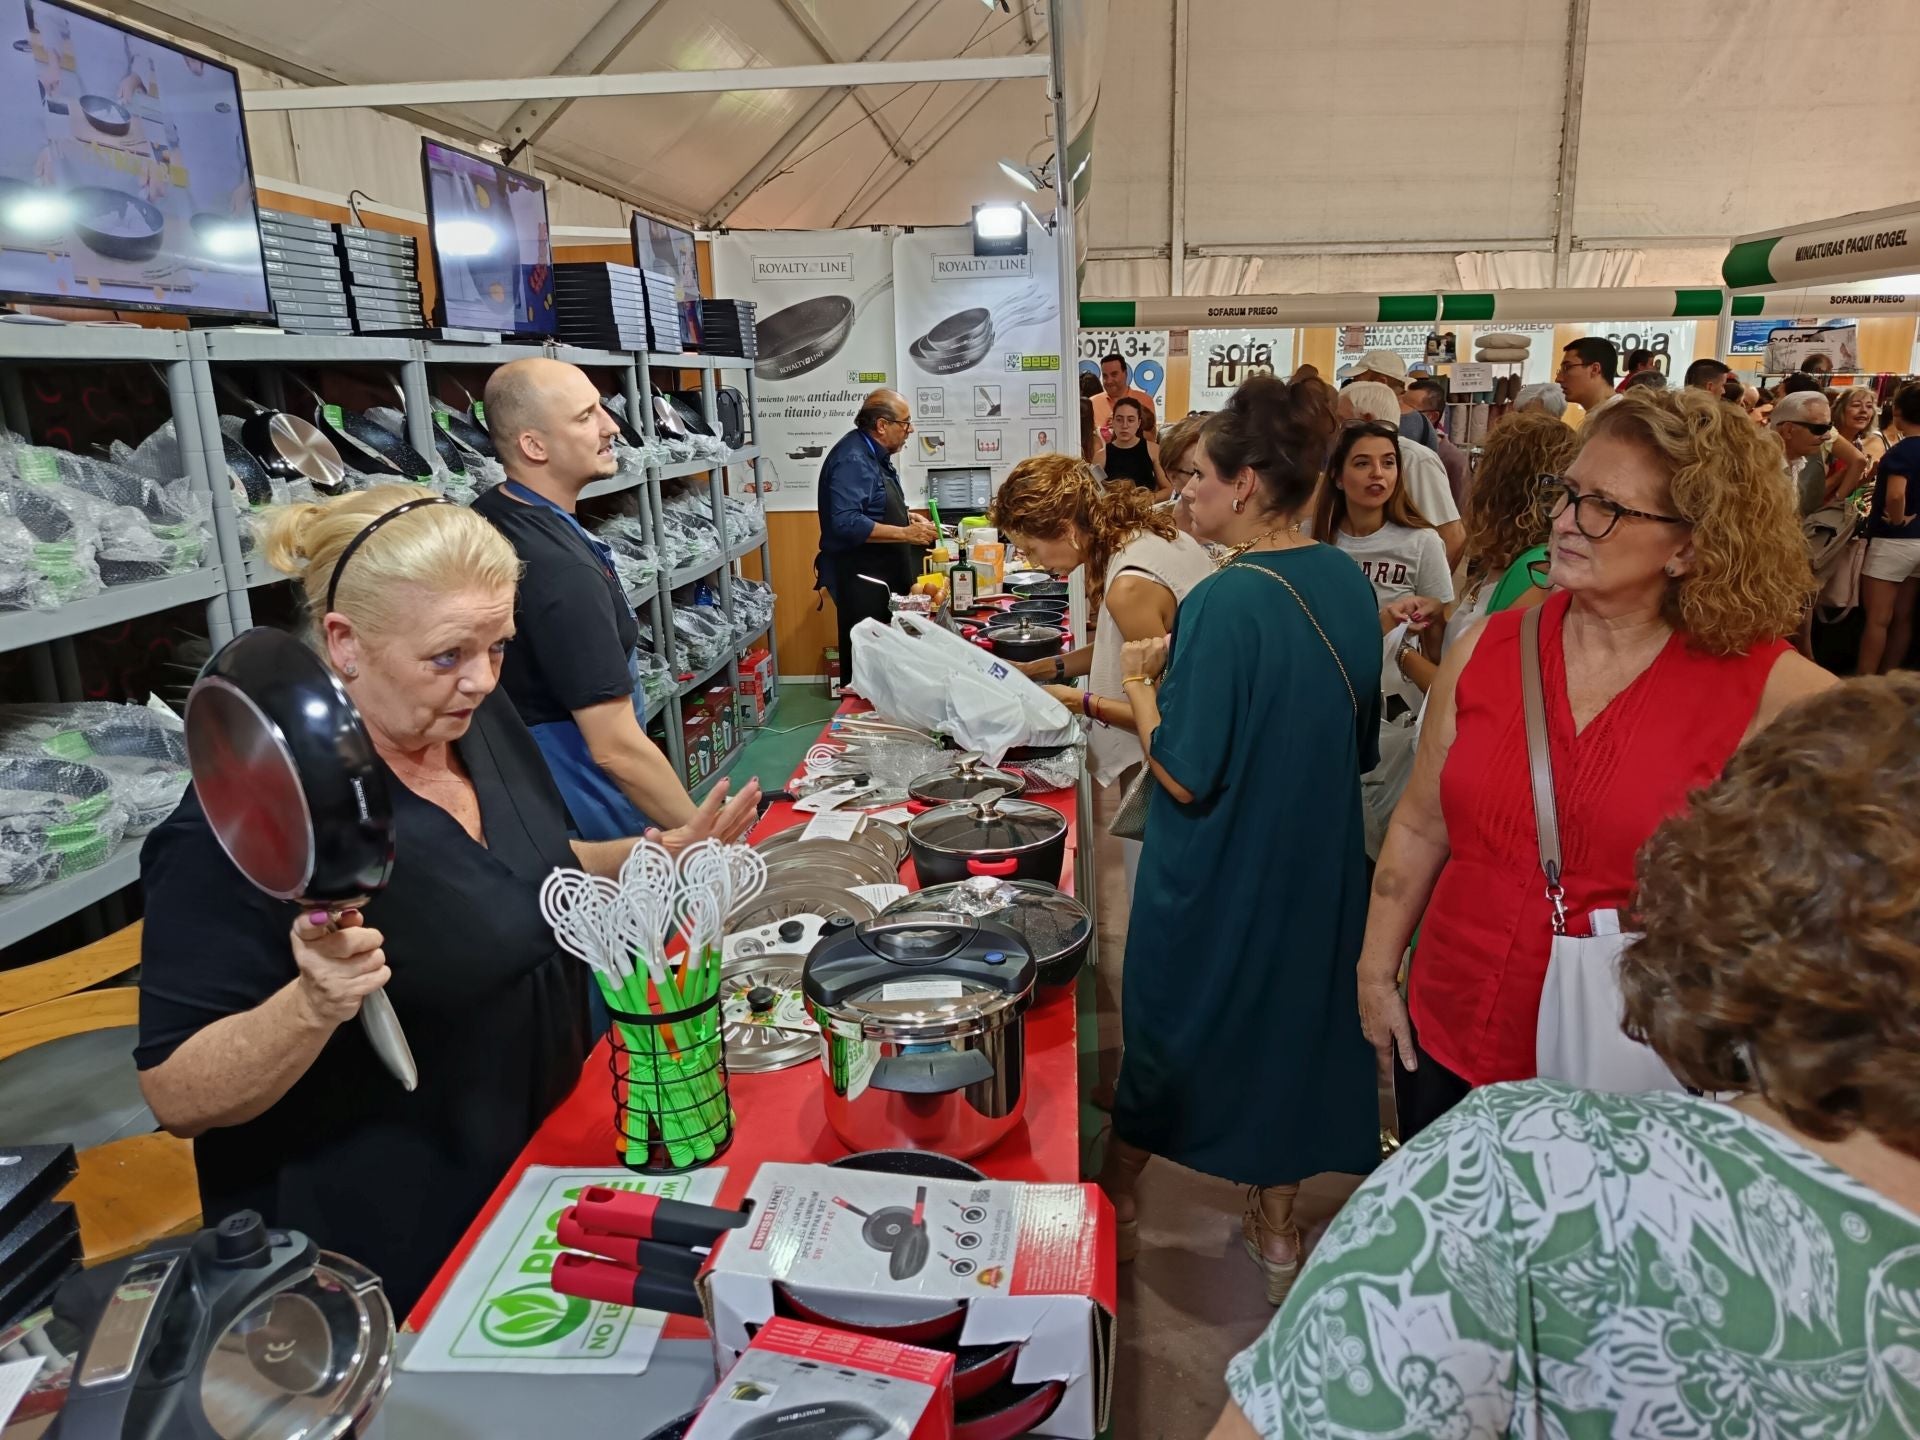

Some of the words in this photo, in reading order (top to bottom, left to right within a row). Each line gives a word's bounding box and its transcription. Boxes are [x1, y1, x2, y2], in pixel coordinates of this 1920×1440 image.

[1795, 240, 1844, 262] MINIATURAS
[1846, 234, 1874, 254] PAQUI
[1875, 229, 1908, 250] ROGEL
[759, 262, 809, 274] ROYALTY
[820, 262, 847, 273] LINE
[938, 260, 988, 273] ROYALTY
[1000, 258, 1027, 270] LINE
[1830, 295, 1871, 304] SOFARUM
[1873, 294, 1905, 303] PRIEGO
[1207, 308, 1246, 317] SOFARUM
[1248, 306, 1278, 316] PRIEGO
[779, 359, 807, 375] ROYALTY
[809, 350, 825, 362] LINE
[786, 395, 806, 404] 100%
[768, 410, 782, 418] con
[784, 405, 822, 418] titanio
[828, 409, 846, 417] libre
[847, 409, 856, 417] de
[752, 1212, 775, 1249] SWISS
[767, 1186, 784, 1211] LINE
[803, 1190, 820, 1230] ALUMINIUM
[807, 1214, 823, 1241] FRYPAN
[817, 1199, 828, 1213] SET
[588, 1323, 614, 1350] NO
